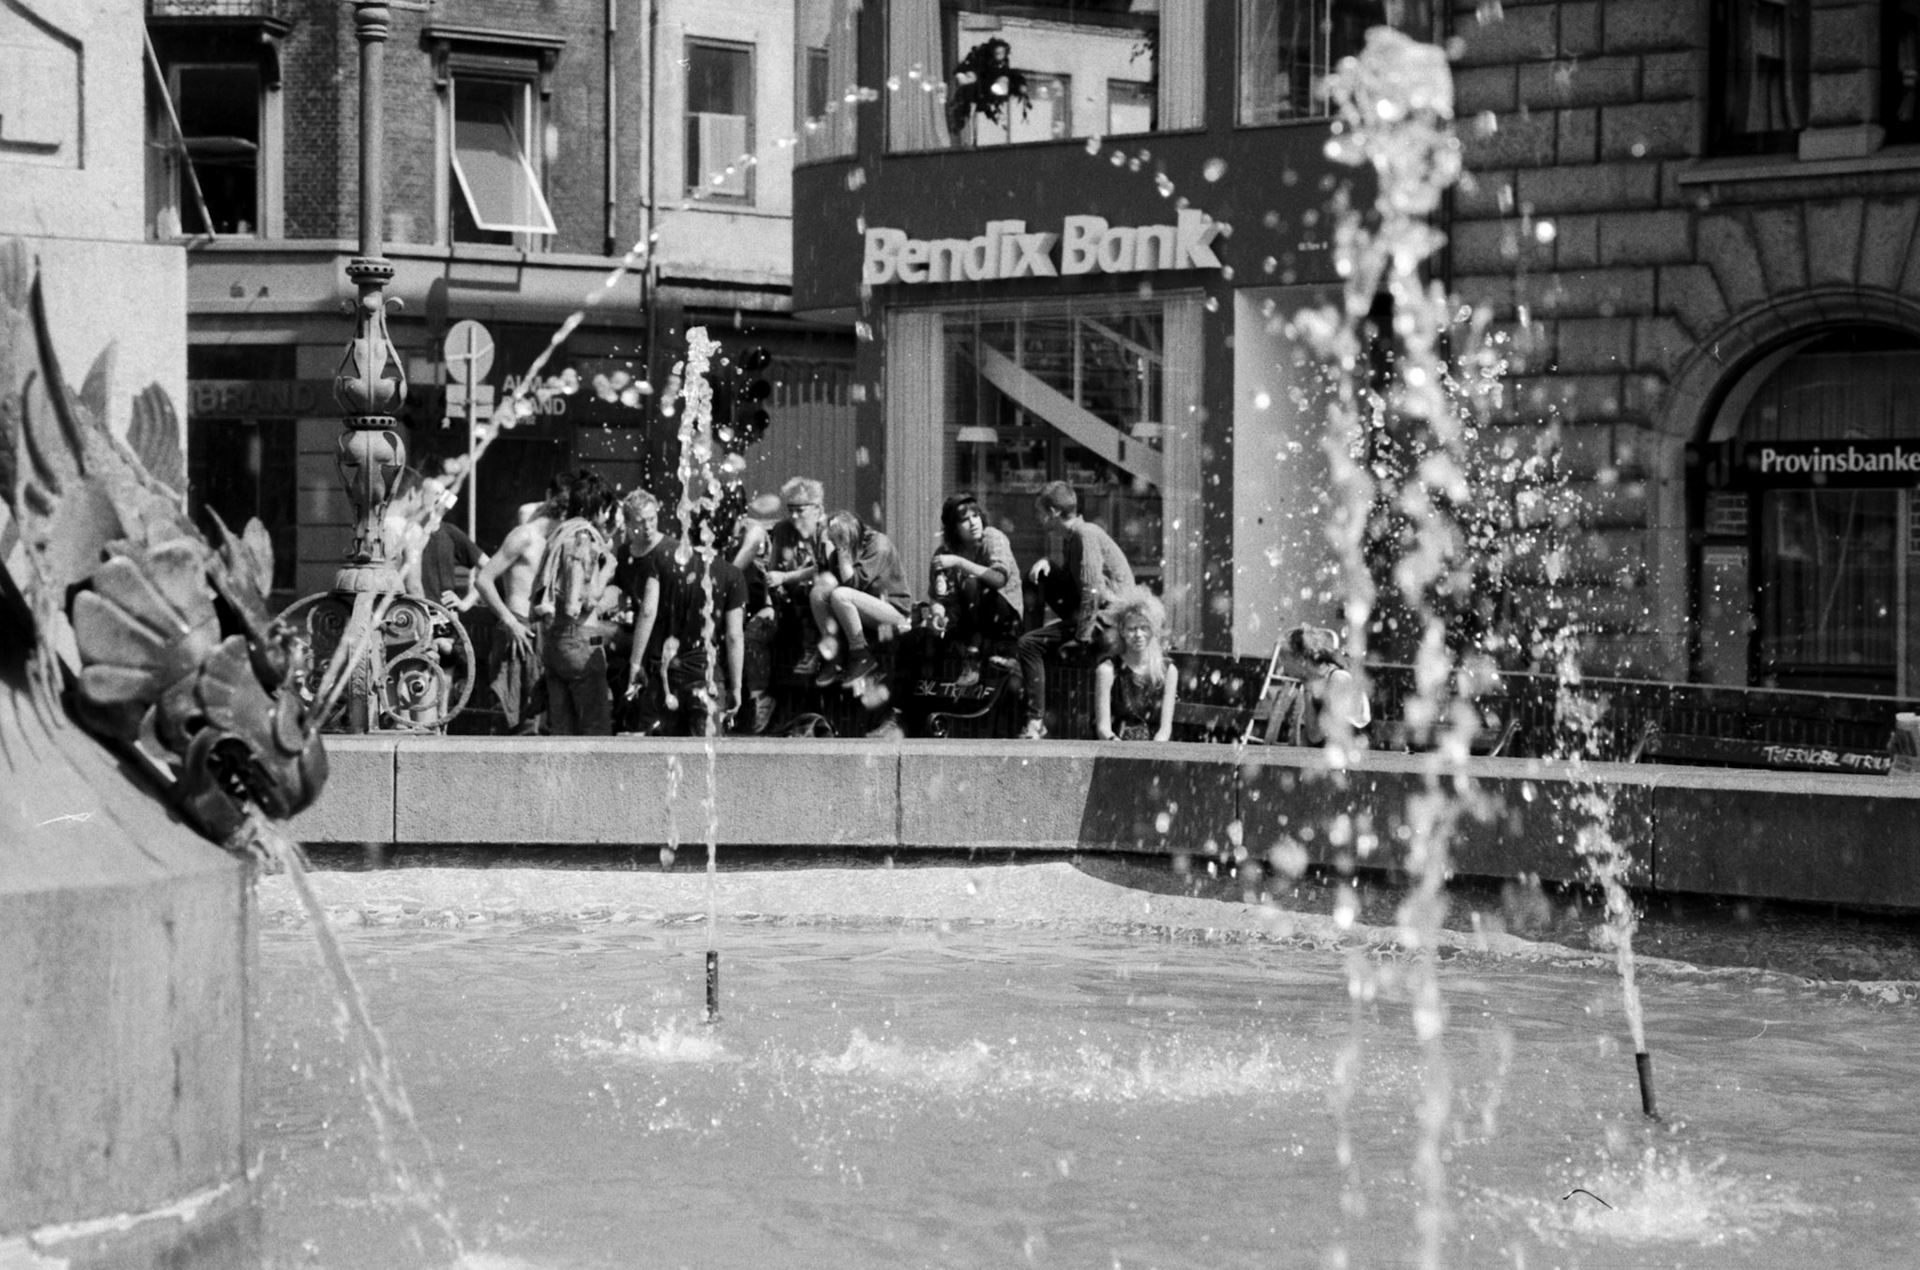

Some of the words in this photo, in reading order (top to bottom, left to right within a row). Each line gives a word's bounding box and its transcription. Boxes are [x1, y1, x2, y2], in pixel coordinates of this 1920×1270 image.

[863, 219, 1058, 285] Bendix
[1061, 208, 1222, 275] Bank
[1761, 445, 1920, 473] Provinsbanke
